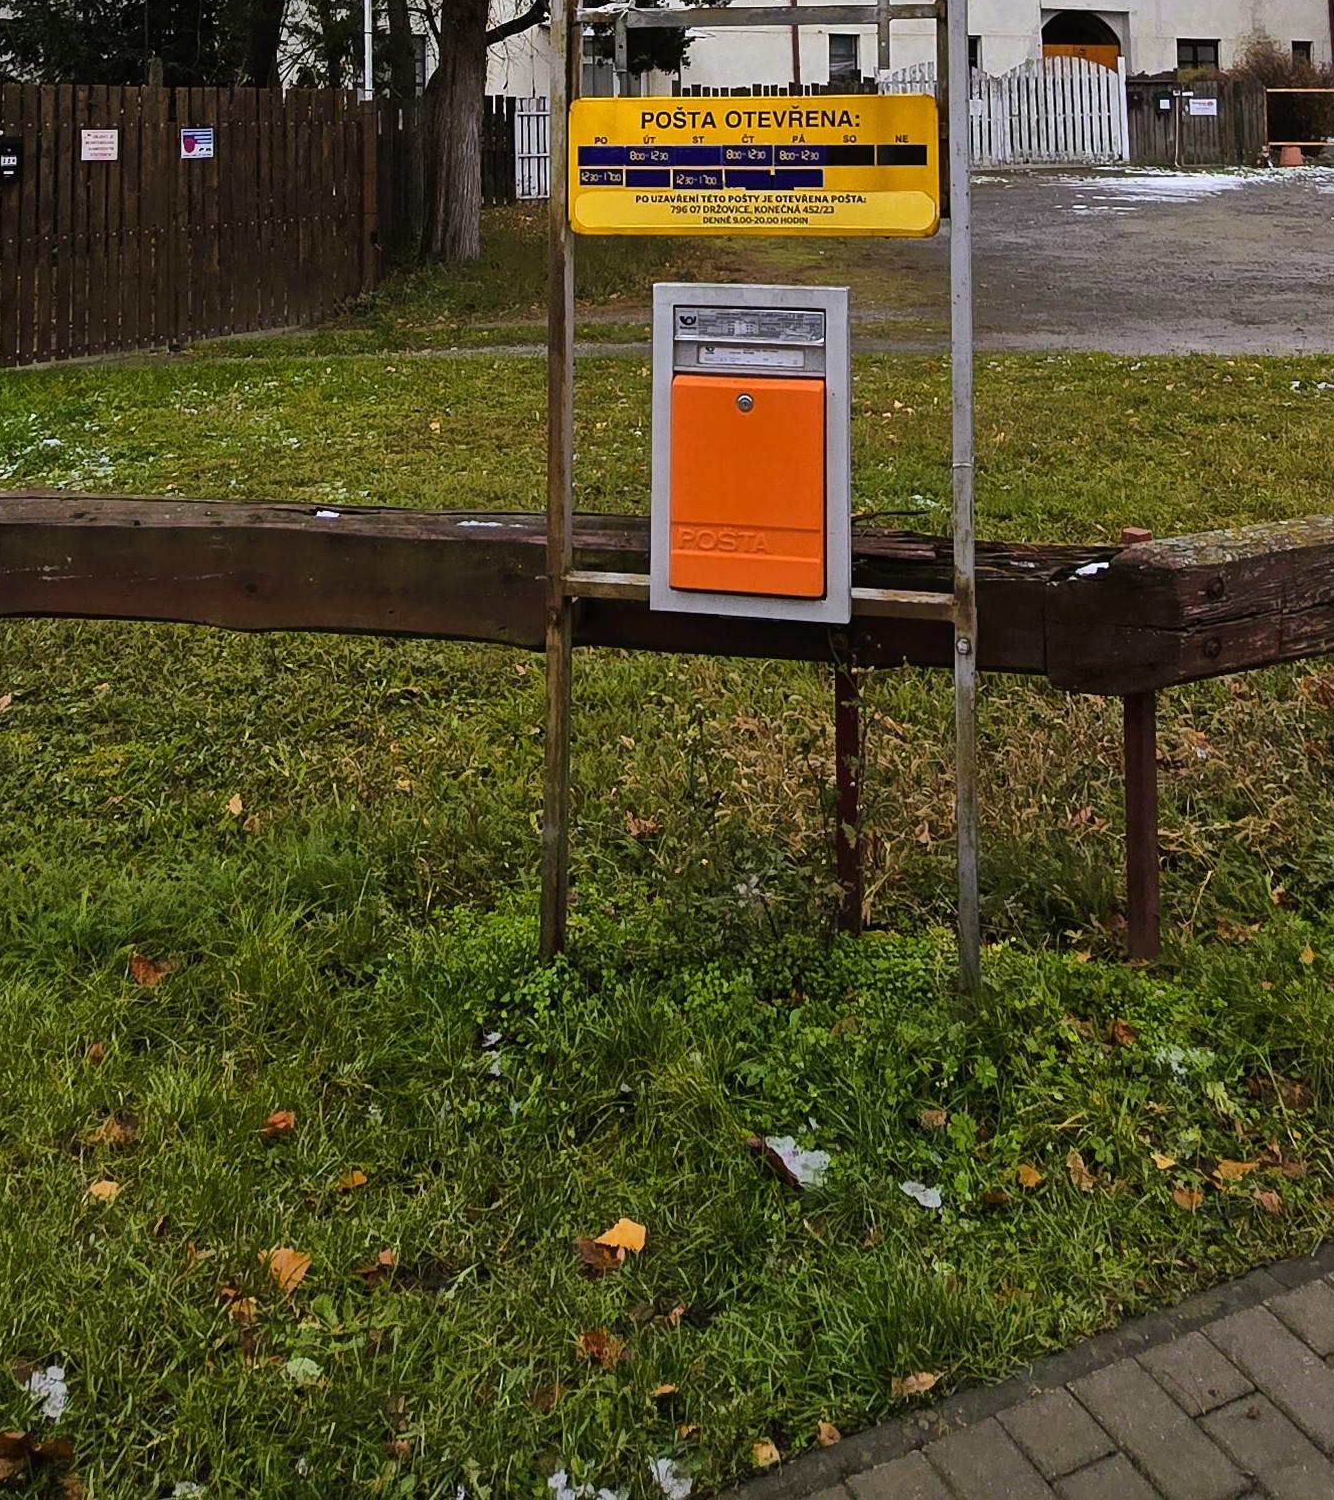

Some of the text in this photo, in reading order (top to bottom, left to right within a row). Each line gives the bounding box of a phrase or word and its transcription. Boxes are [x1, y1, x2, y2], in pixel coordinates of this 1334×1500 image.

[640, 105, 861, 129] POŠTA OTEVŘENA:
[594, 133, 909, 145] PO ÚT ST ČT PÁ SO NE
[635, 193, 867, 203] PO UZAVŘENÍ TÉTO POŠTY JE OTEVŘENA POŠTA:
[670, 205, 687, 213] 796
[702, 204, 753, 214] DRŽOVICE,
[754, 204, 801, 213] KONEČNÁ
[802, 205, 835, 214] 452/23
[732, 216, 779, 224] 9.00-20.00
[780, 216, 809, 224] HODIN
[677, 527, 774, 556] POŠTA
